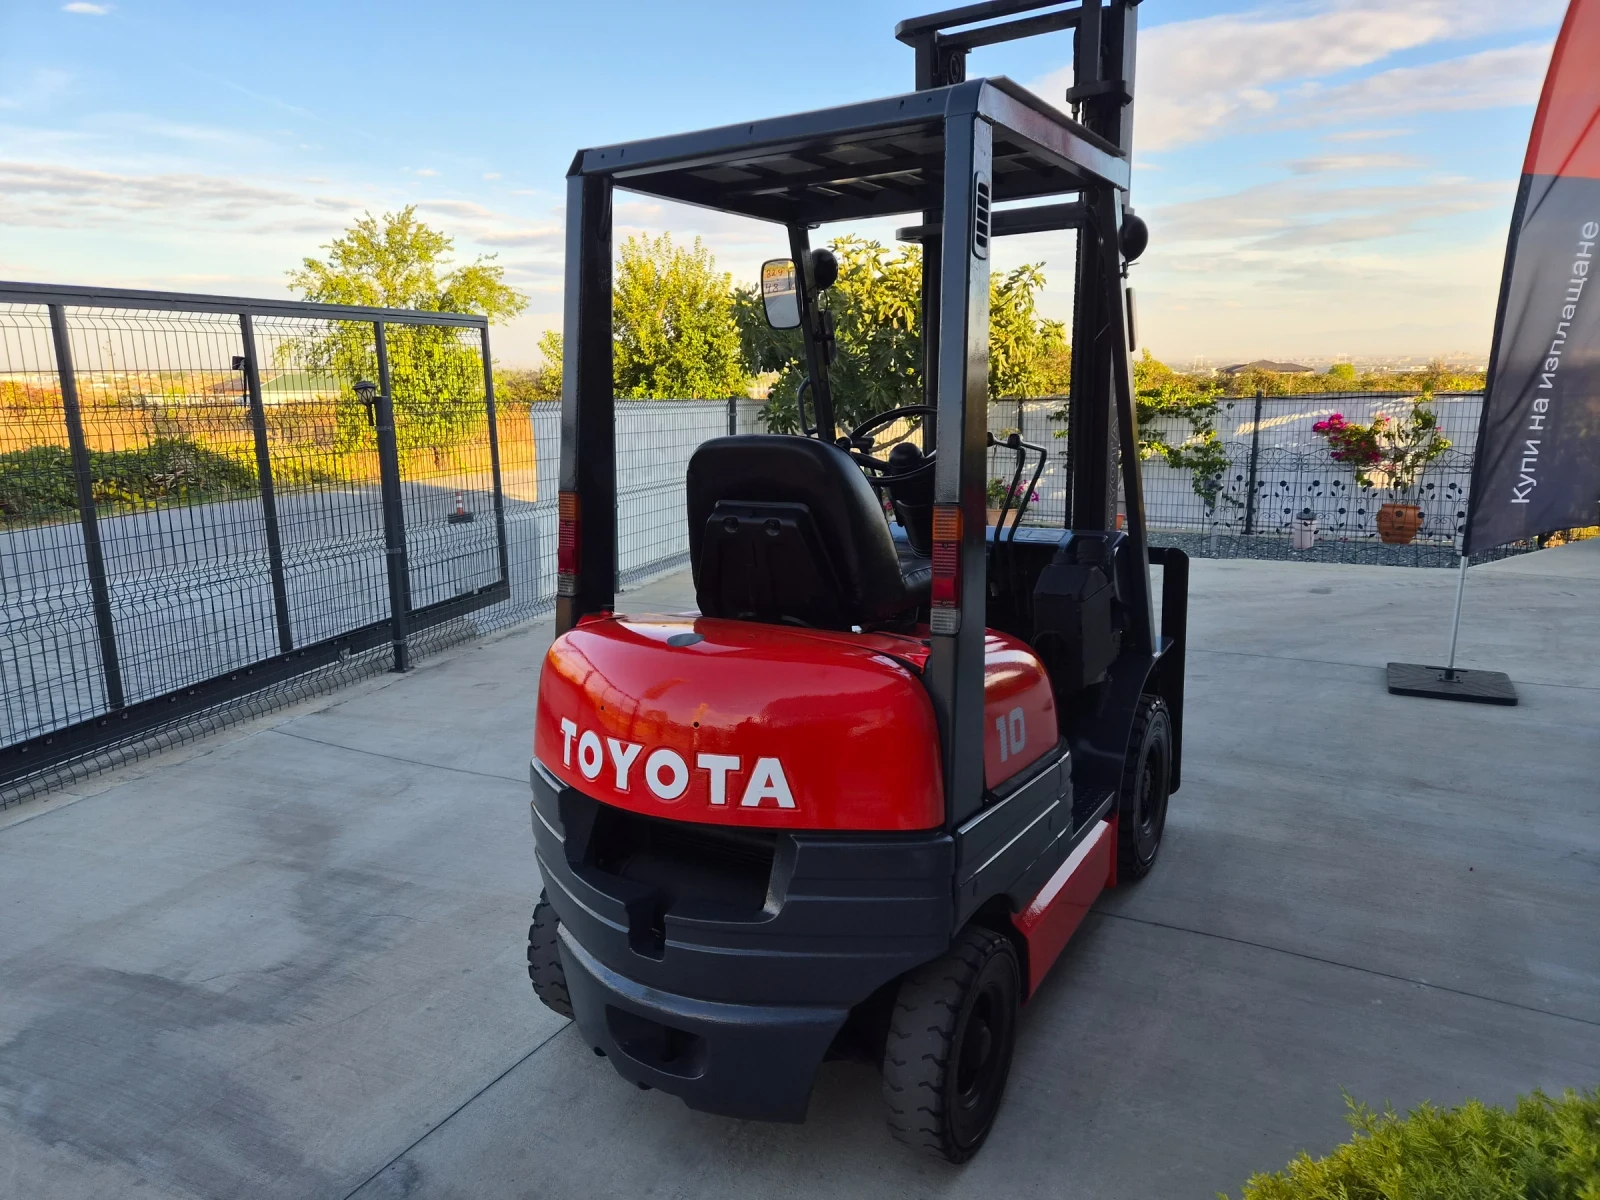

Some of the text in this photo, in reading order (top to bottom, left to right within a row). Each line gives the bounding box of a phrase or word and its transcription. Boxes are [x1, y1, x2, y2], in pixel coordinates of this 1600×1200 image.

[1511, 220, 1600, 504] Купи на изплащане
[1107, 417, 1119, 529] OYOTA
[560, 717, 796, 809] TOYOTA
[995, 705, 1026, 764] 10
